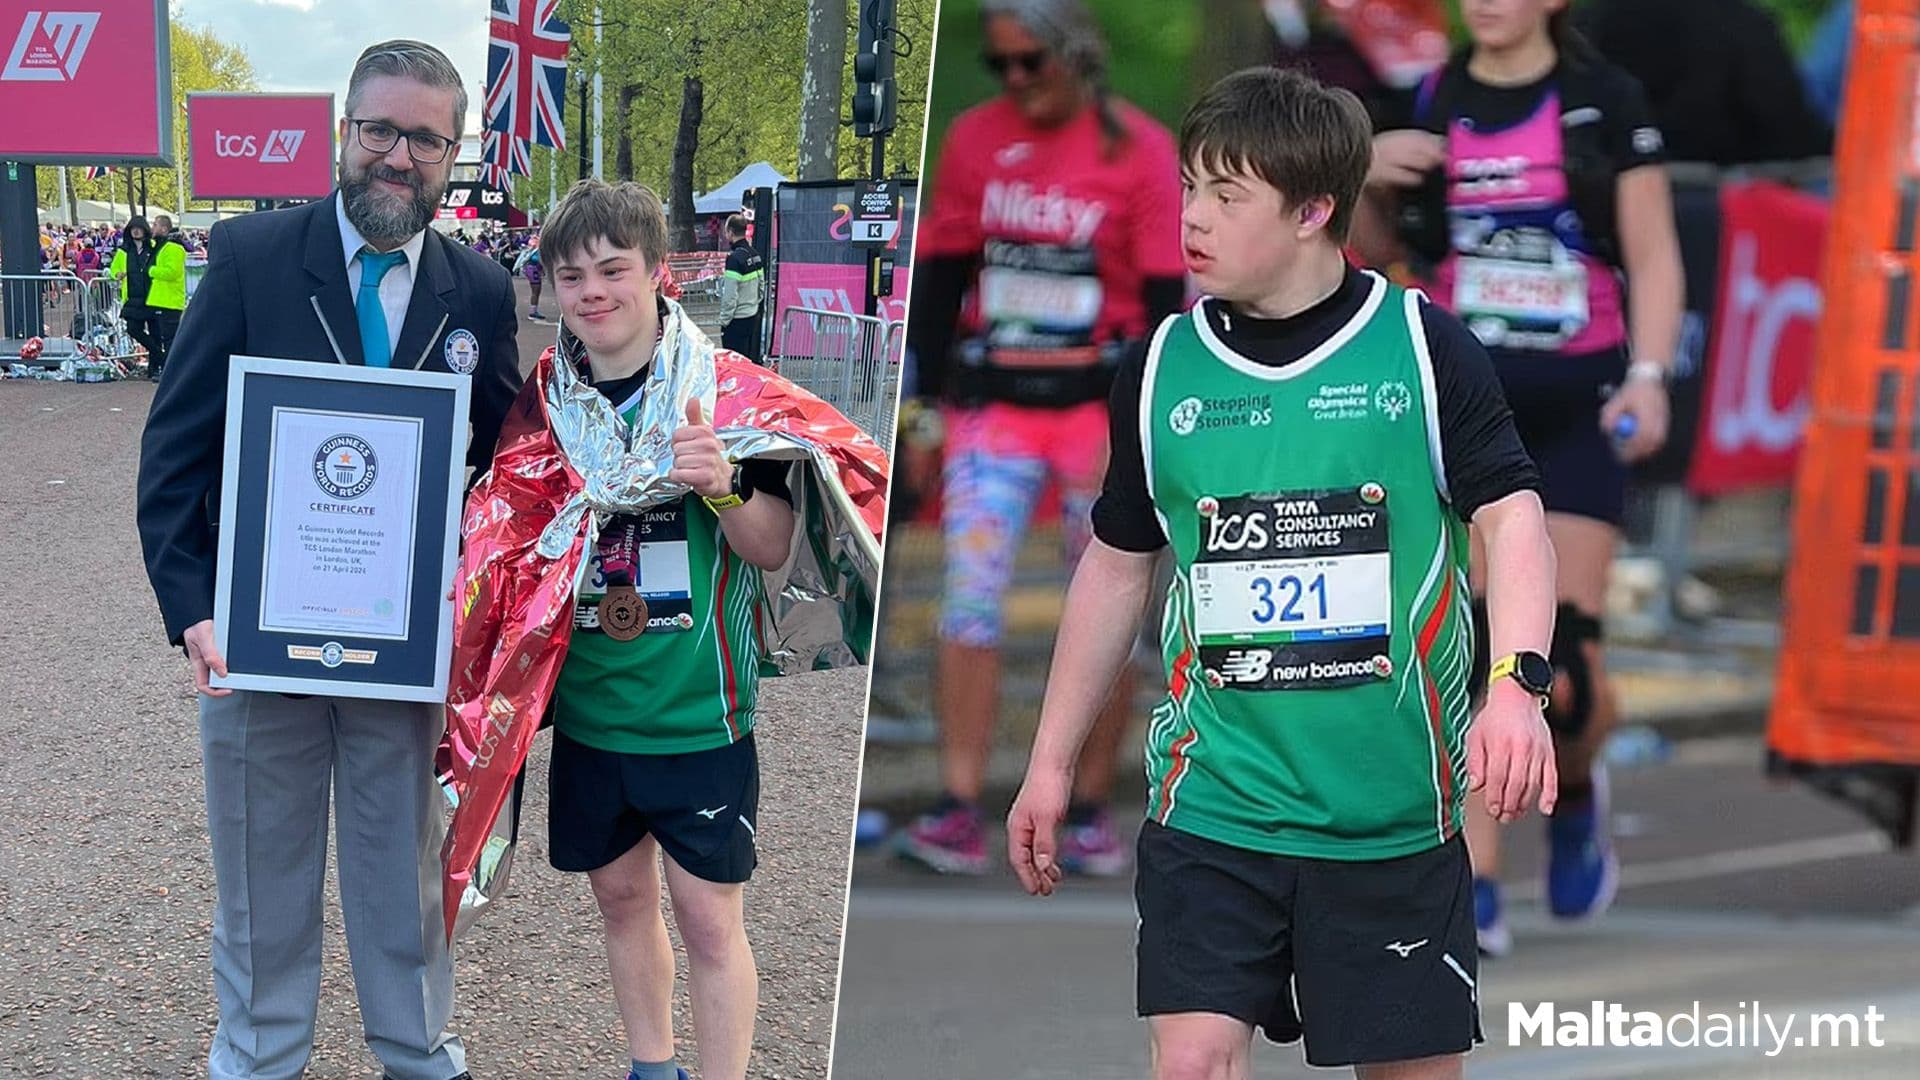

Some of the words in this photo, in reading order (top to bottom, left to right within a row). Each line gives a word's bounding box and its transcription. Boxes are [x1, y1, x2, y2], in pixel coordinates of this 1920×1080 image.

[215, 129, 257, 157] tcs
[481, 189, 504, 205] tcs
[981, 180, 1107, 246] Nicky
[871, 224, 880, 237] K
[1708, 232, 1825, 452] tc
[1319, 383, 1368, 398] Special
[1202, 393, 1272, 412] Stepping
[1308, 396, 1368, 410] Olympics
[322, 437, 371, 458] GUINNESS
[316, 460, 337, 493] WORLD
[339, 464, 376, 497] RECORDS
[309, 502, 376, 515] CERTIFICATE
[1273, 501, 1319, 516] TATA
[1274, 512, 1377, 533] CONSULTANCY
[304, 525, 334, 533] Guinness
[358, 529, 384, 537] Records
[1206, 512, 1269, 552] tcs
[331, 537, 361, 545] achieved
[1275, 531, 1342, 549] SERVICES
[304, 544, 318, 552] TCS
[319, 545, 343, 553] London
[344, 547, 376, 556] Marathon
[316, 554, 322, 562] in
[332, 566, 348, 574] April
[349, 567, 366, 575] 2024
[1250, 573, 1328, 624] 321
[301, 605, 337, 613] OFFICIALLY
[1273, 665, 1309, 681] new
[1310, 660, 1374, 678] balance
